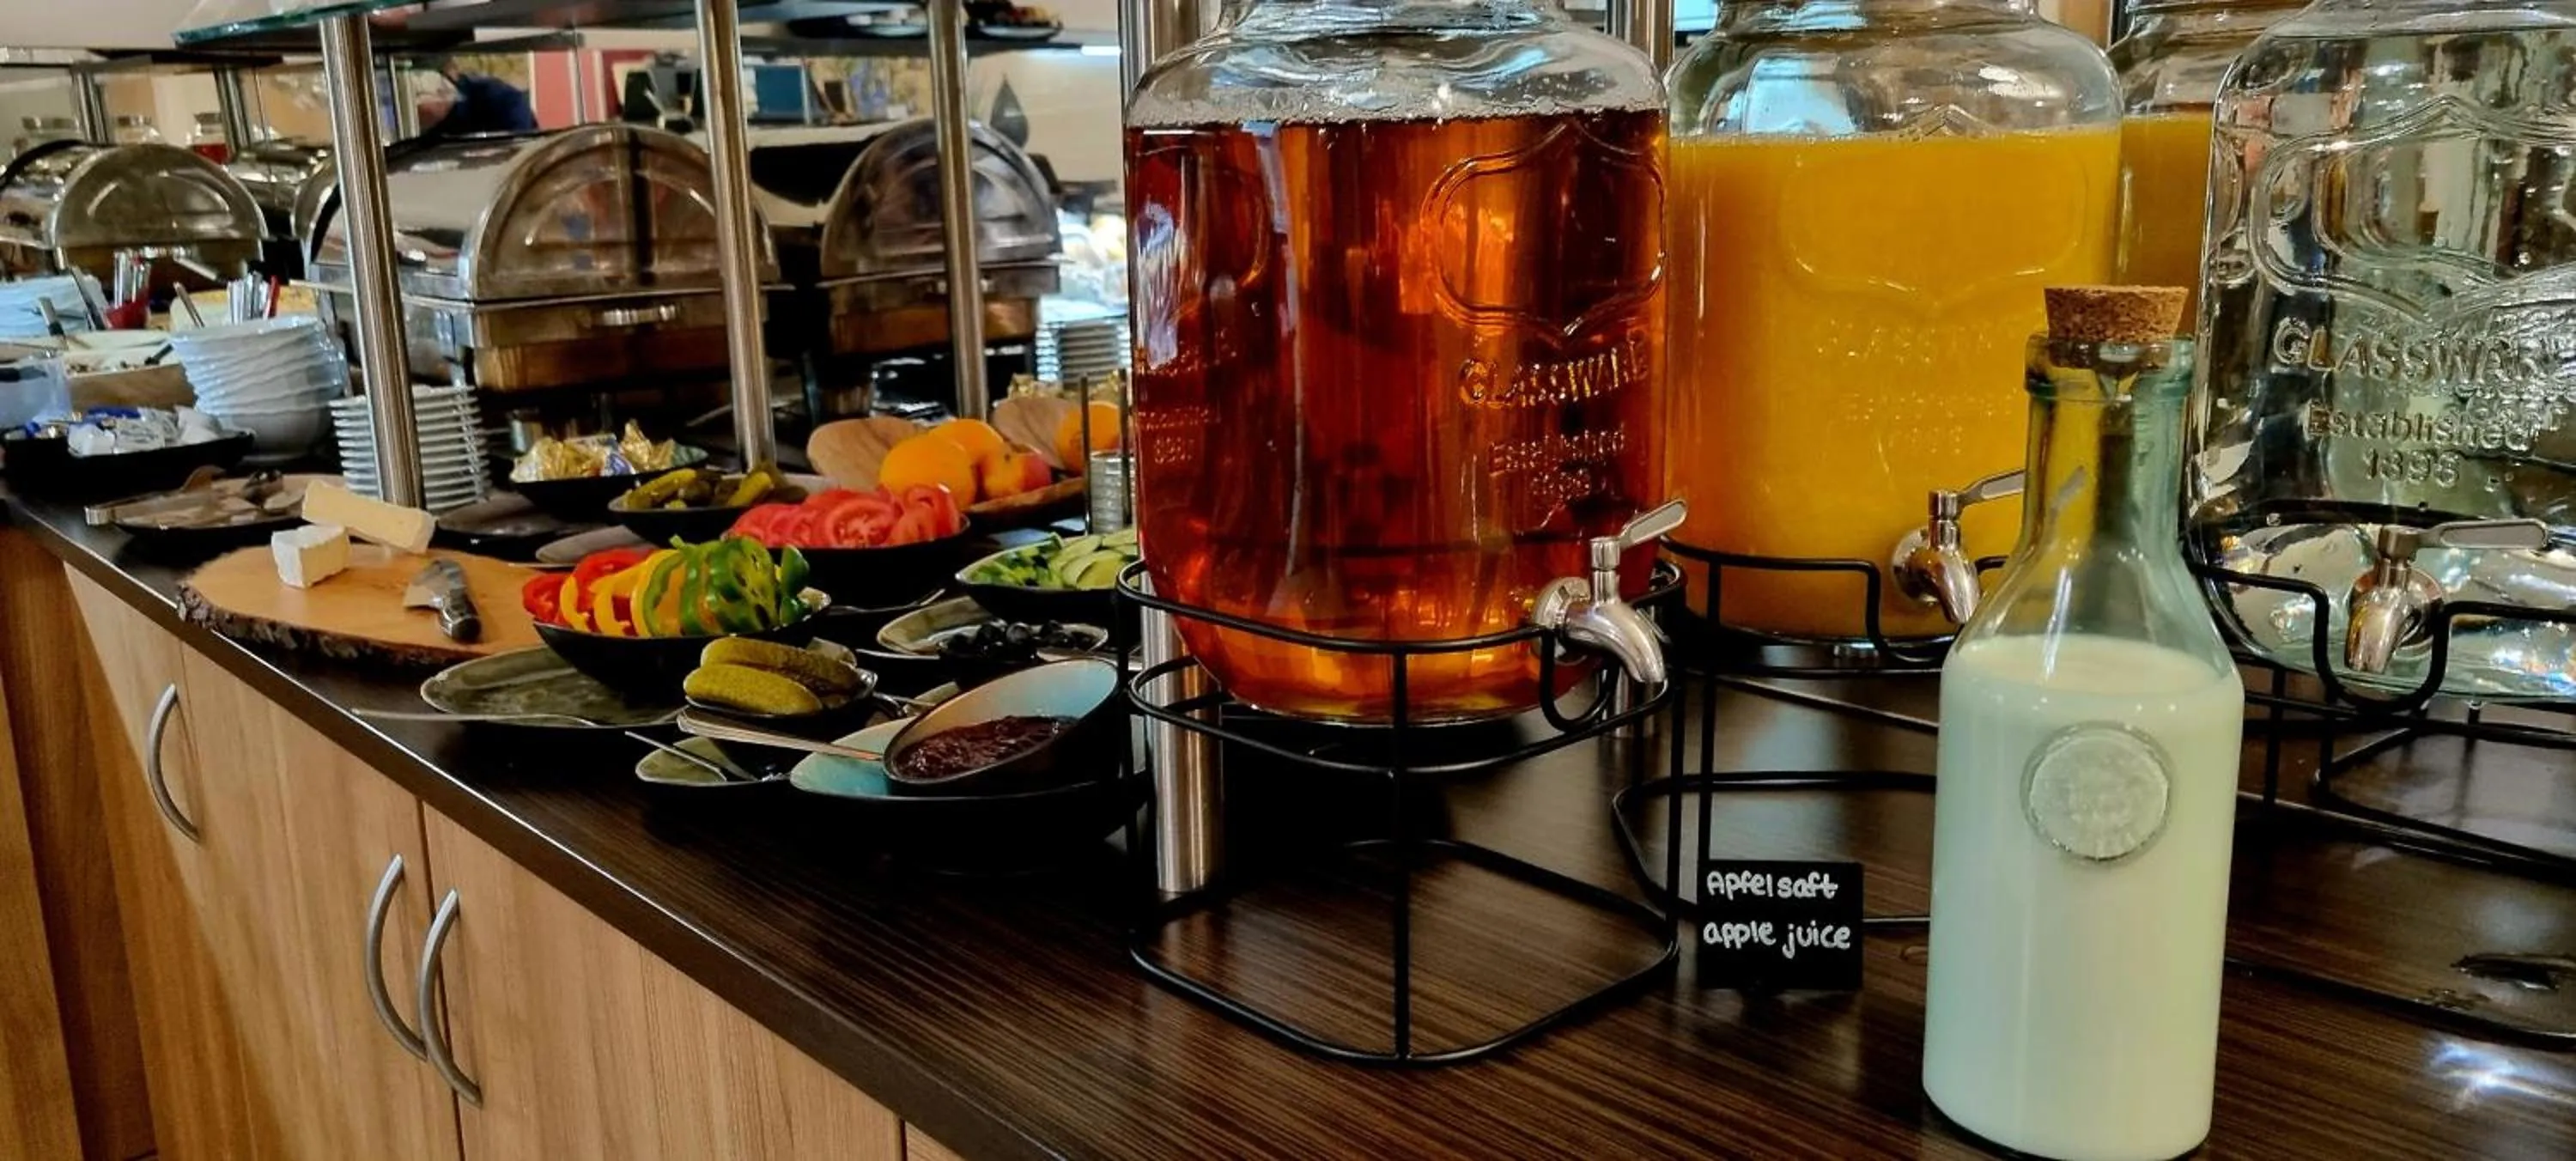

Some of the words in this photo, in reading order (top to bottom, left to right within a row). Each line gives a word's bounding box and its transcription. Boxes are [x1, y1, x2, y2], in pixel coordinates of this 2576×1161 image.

[2273, 316, 2566, 383] GLASSWAR
[2303, 398, 2533, 453] Established
[1706, 870, 1838, 900] Apfelsaft
[1703, 921, 1776, 949] apple
[1782, 920, 1851, 959] juice
